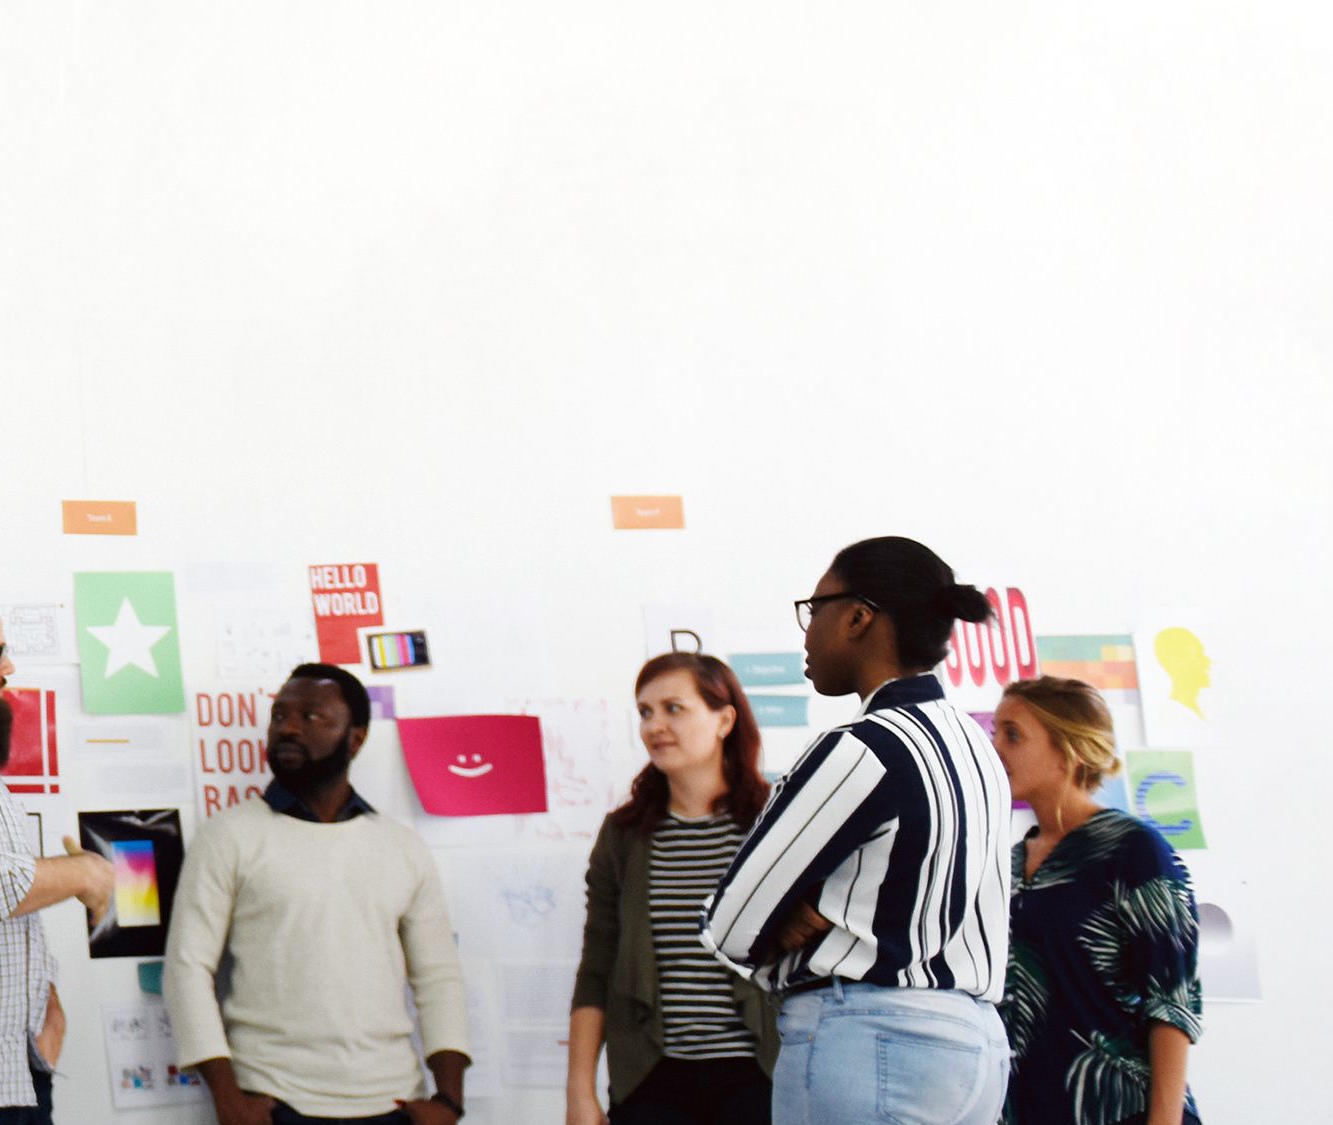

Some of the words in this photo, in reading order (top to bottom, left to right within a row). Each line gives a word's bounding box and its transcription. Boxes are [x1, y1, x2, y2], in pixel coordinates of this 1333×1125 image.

[310, 565, 367, 590] HELLO
[313, 591, 379, 616] WORLD
[196, 687, 278, 728] DON'
[1135, 770, 1193, 835] C
